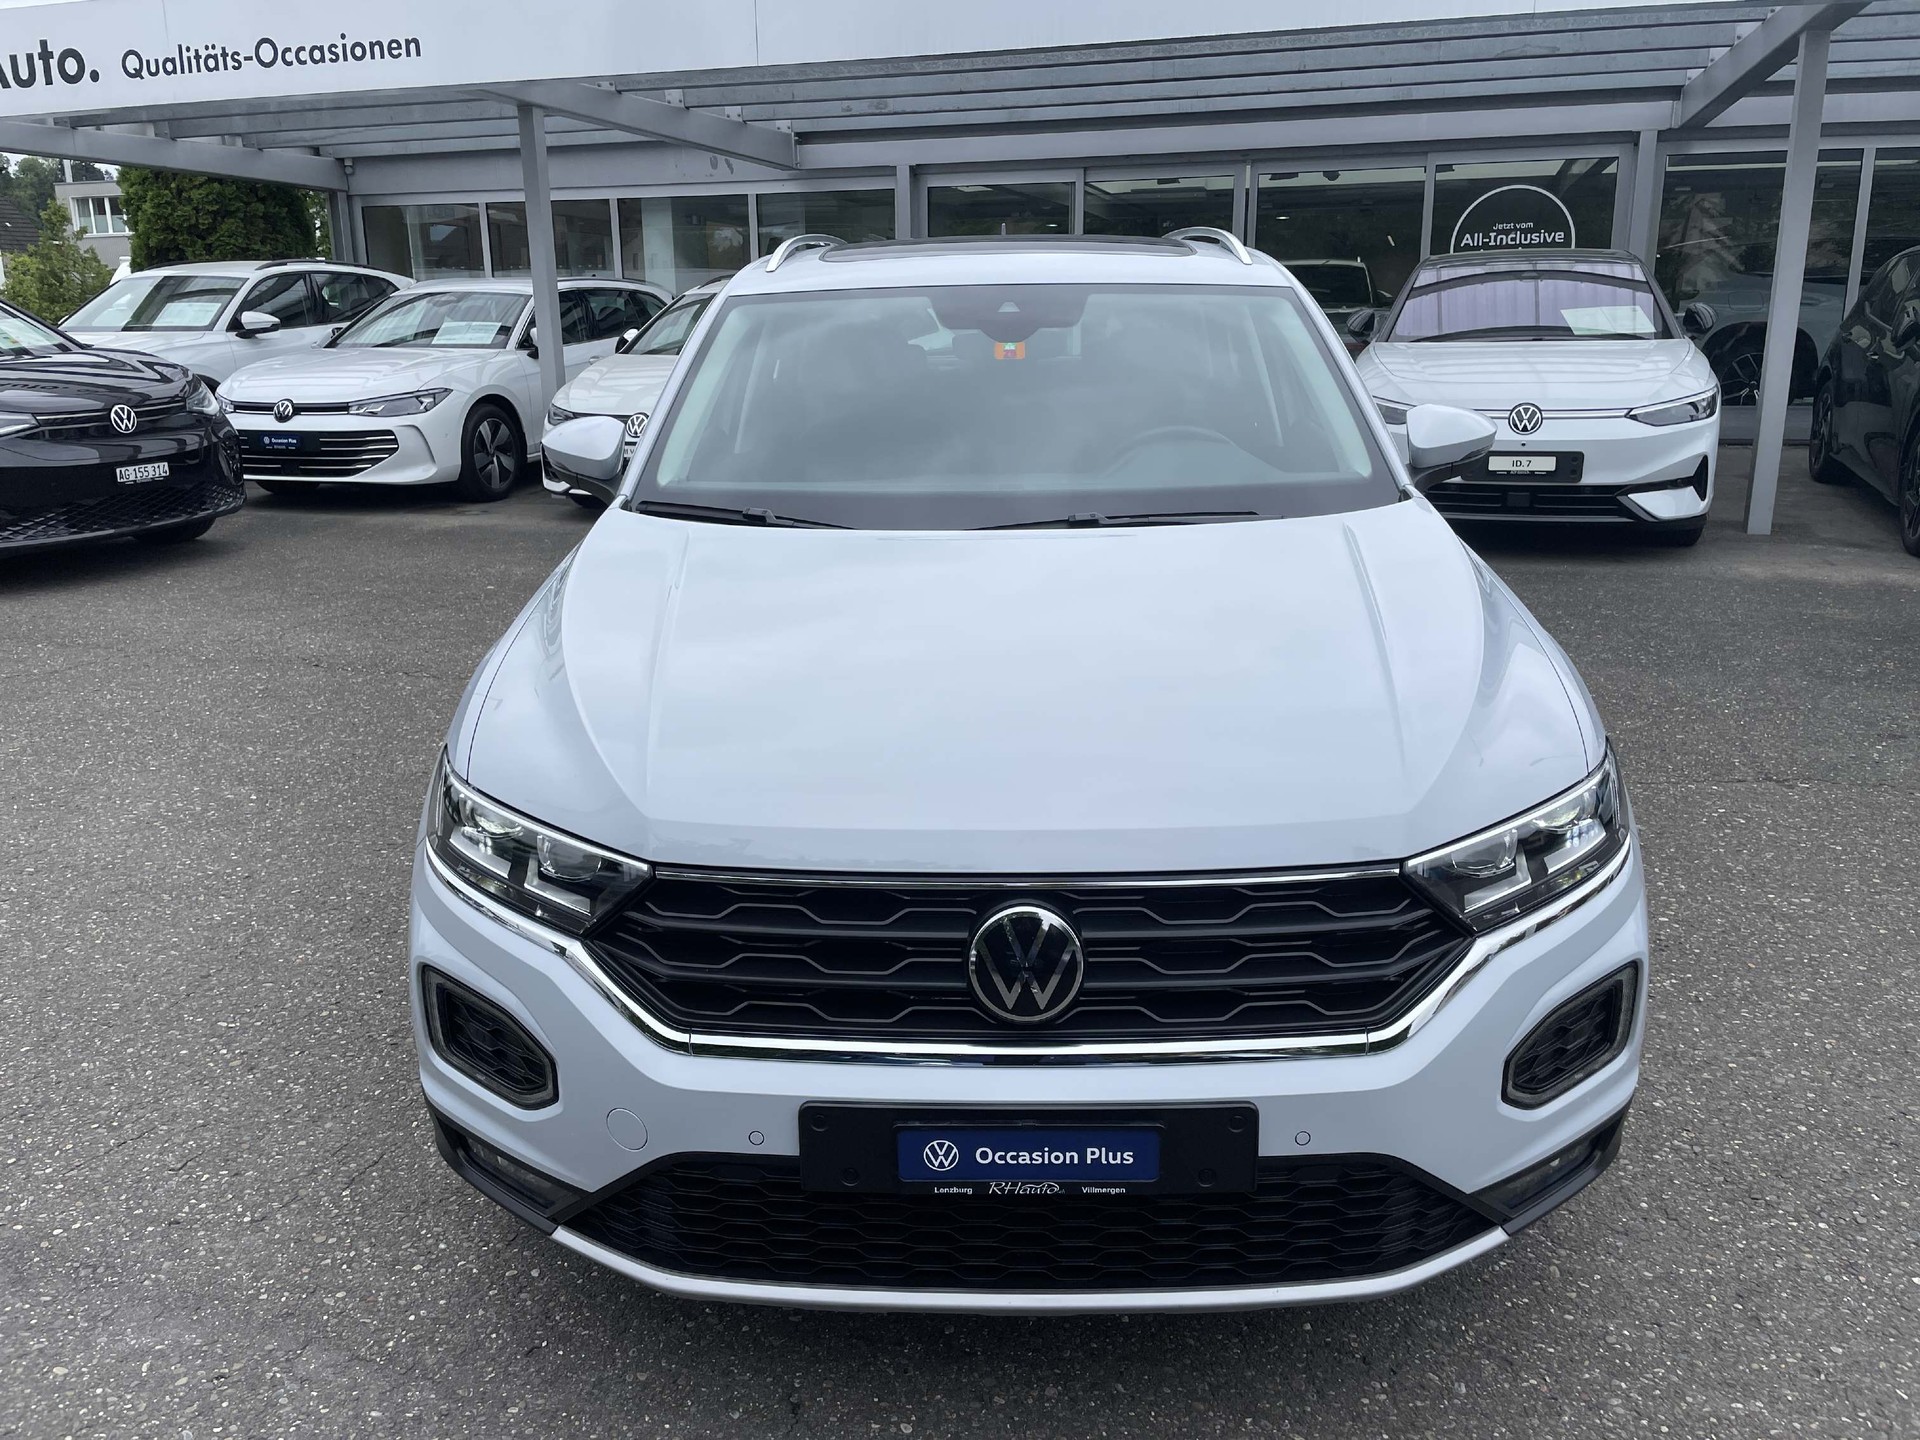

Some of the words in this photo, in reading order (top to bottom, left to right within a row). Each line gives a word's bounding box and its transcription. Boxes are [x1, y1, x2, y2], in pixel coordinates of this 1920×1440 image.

[121, 32, 421, 80] Qualitäts-Occasionen
[1493, 222, 1514, 230] Jetzt
[1461, 229, 1565, 247] All-Inclusive
[975, 1147, 1079, 1164] Occasion
[1086, 1147, 1134, 1164] Plus
[934, 1186, 973, 1194] Lenzburg
[1081, 1186, 1126, 1195] Villmergen
